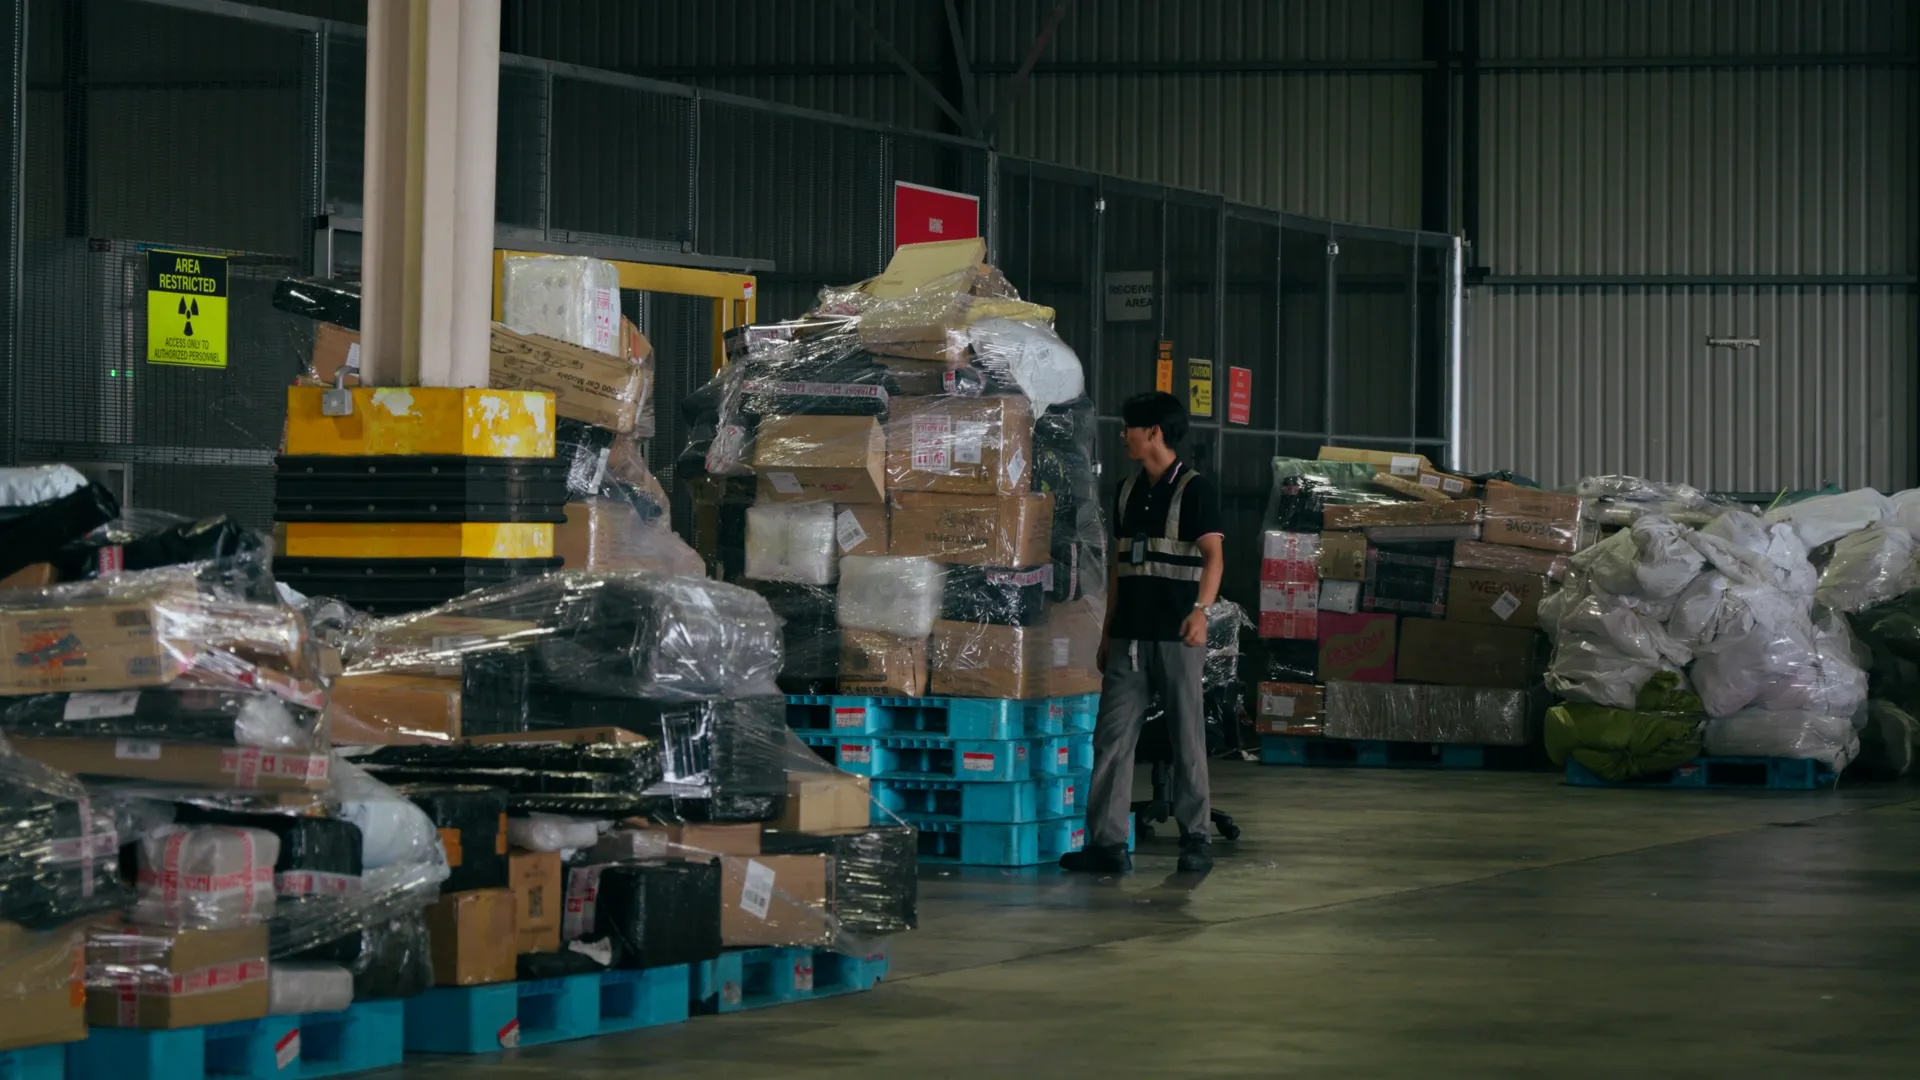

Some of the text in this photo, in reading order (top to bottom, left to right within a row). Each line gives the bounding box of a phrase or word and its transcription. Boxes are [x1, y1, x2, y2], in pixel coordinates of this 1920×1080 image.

[175, 257, 200, 274] AREA
[159, 273, 216, 293] RESTRICTED
[1125, 298, 1153, 308] AREA
[165, 337, 209, 350] ACCESS ONLY TO
[153, 348, 220, 363] AUTHORIZED PERSONNEL
[556, 371, 585, 385] Models
[586, 380, 600, 390] Car
